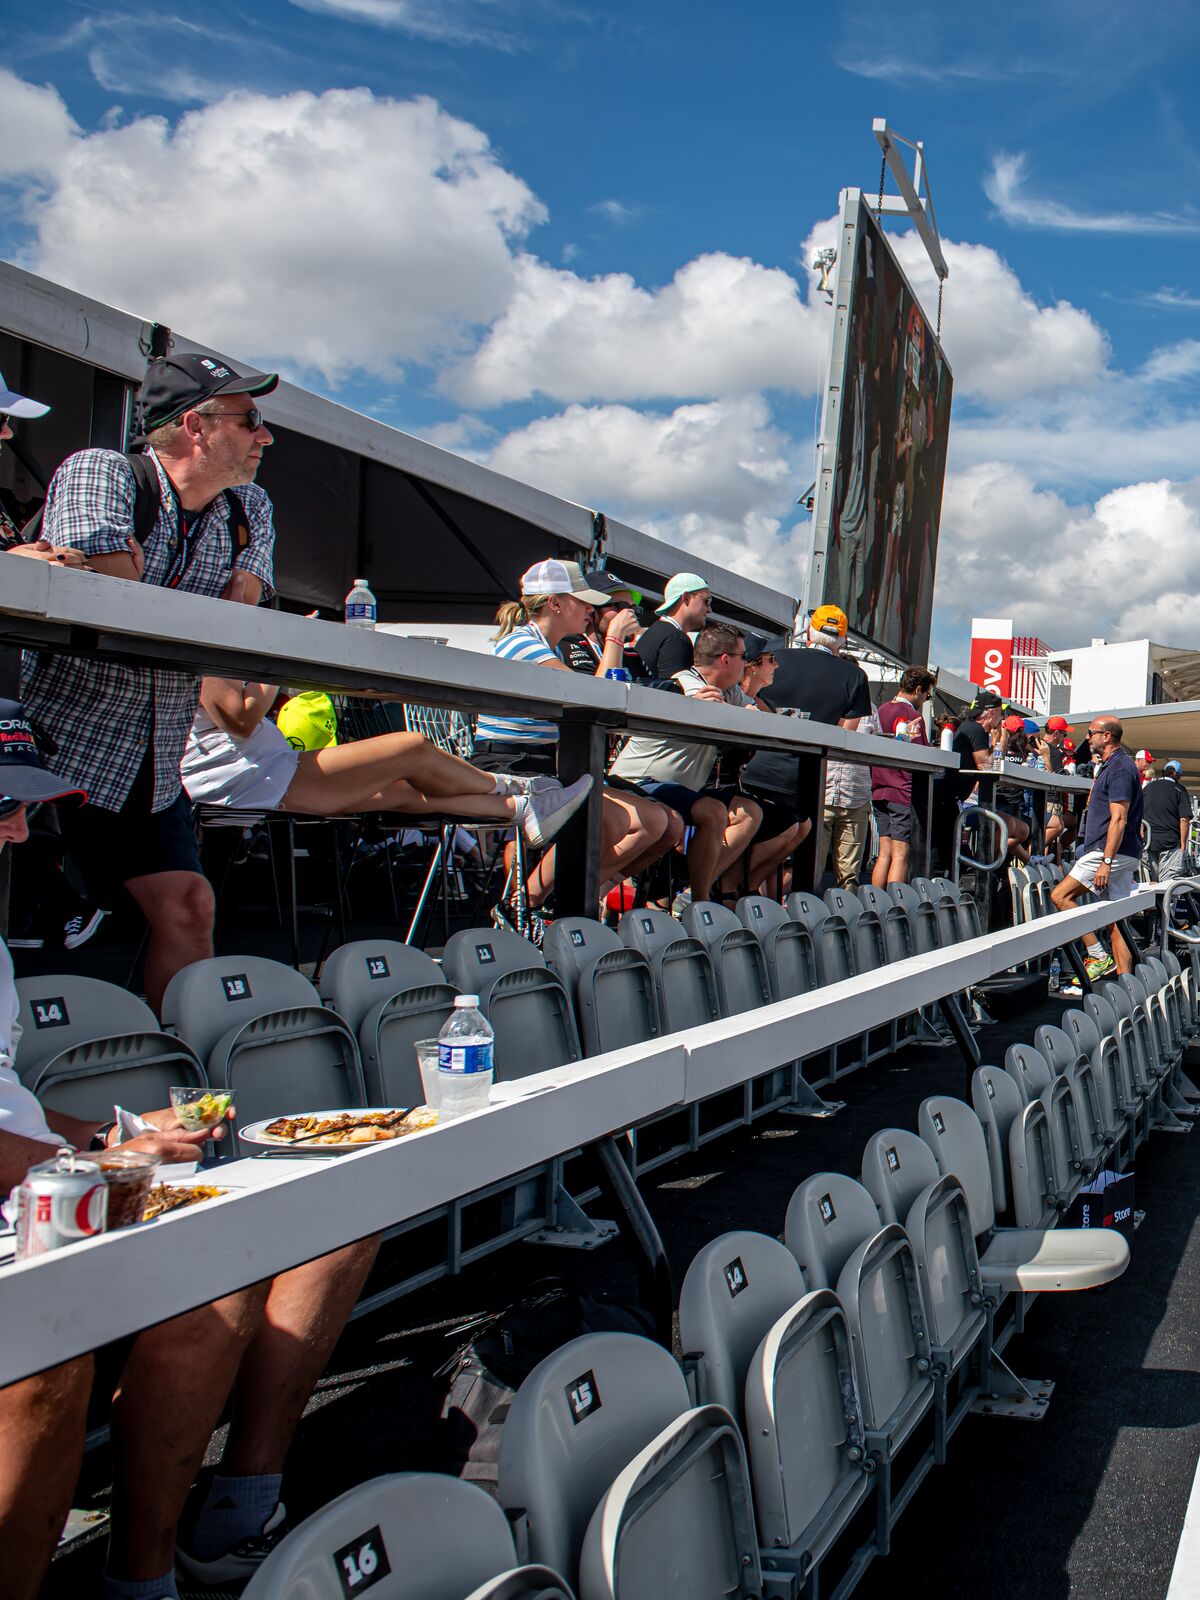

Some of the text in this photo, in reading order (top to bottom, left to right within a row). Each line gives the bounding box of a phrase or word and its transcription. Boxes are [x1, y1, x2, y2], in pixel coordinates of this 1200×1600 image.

[571, 933, 582, 944] 10
[479, 948, 491, 960] 11
[370, 960, 385, 975] 12
[227, 980, 245, 996] 13
[37, 1003, 62, 1023] 14
[820, 1201, 832, 1220] 13
[1114, 1207, 1131, 1222] Store
[728, 1266, 744, 1291] 14
[571, 1382, 593, 1414] 15
[343, 1543, 378, 1586] 16
